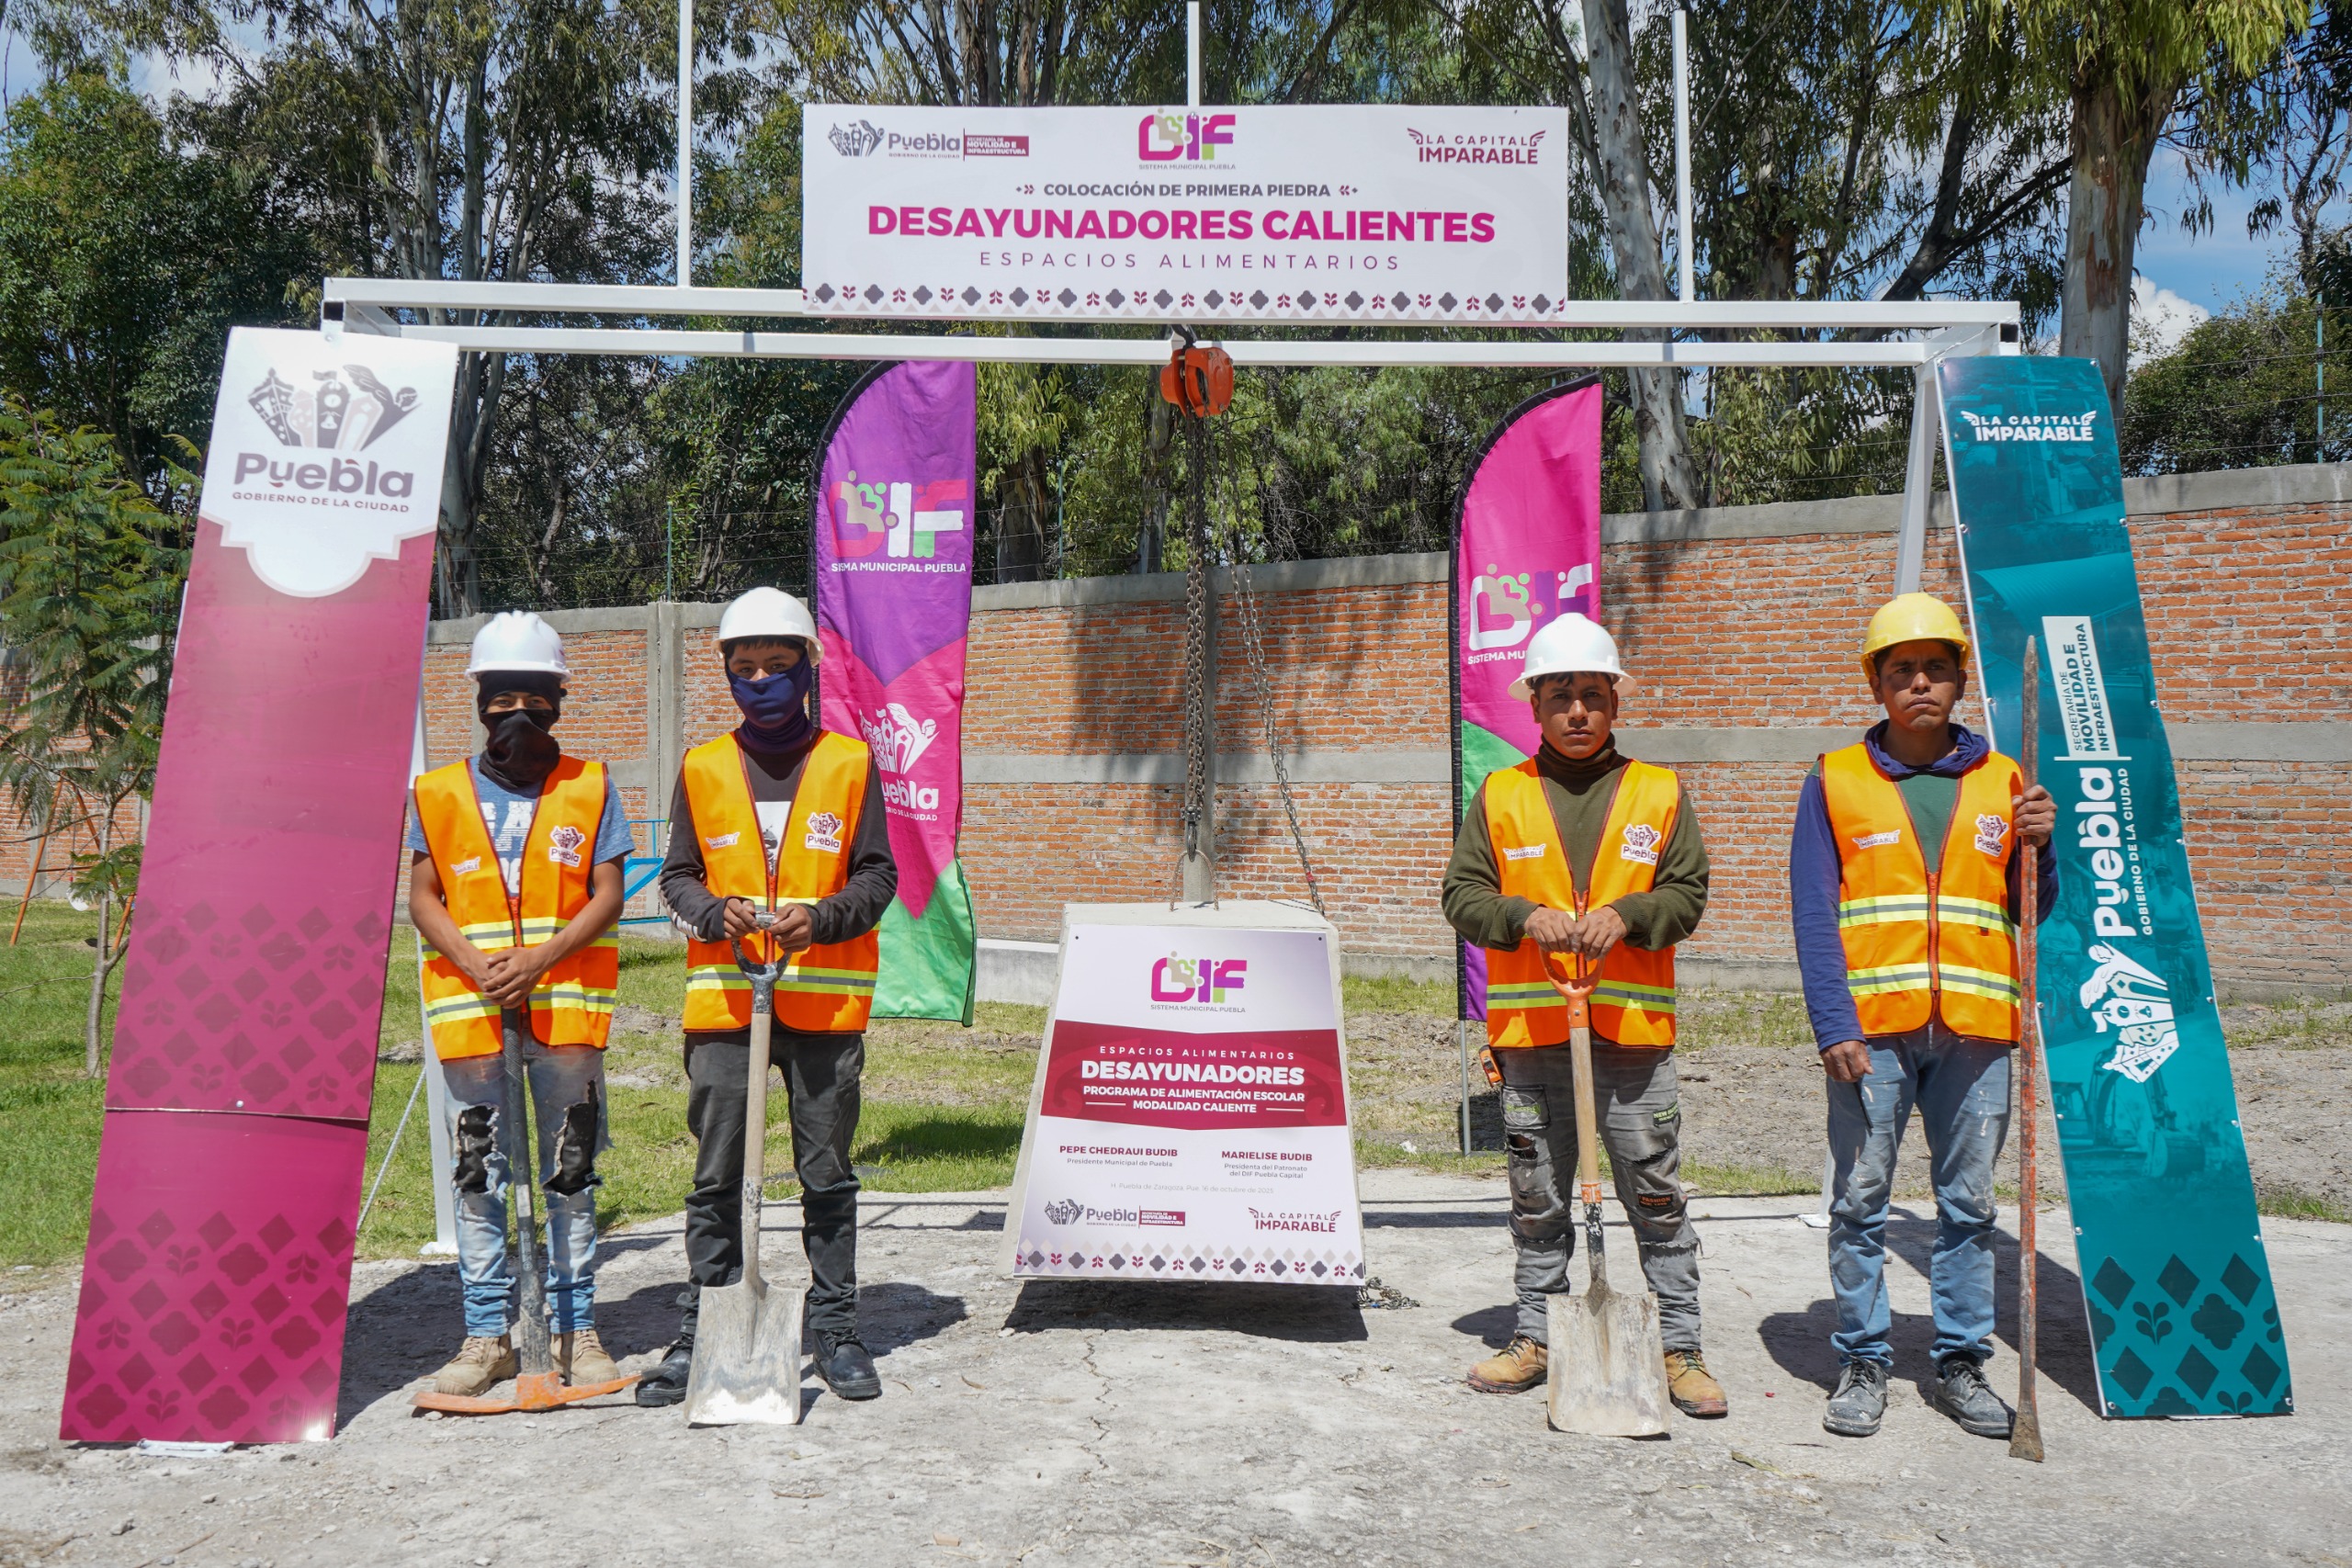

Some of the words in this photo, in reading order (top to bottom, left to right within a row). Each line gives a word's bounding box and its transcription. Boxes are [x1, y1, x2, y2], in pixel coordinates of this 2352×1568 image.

[888, 133, 960, 152] Puebla
[1427, 135, 1445, 144] LA
[1454, 135, 1528, 146] CAPITAL
[1419, 147, 1538, 164] IMPARABLE
[1044, 181, 1155, 197] COLOCACIÓN
[1159, 184, 1182, 197] DE
[1185, 184, 1263, 197] PRIMERA
[1267, 184, 1331, 197] PIEDRA
[868, 206, 1253, 240] DESAYUNADORES
[1262, 210, 1495, 243] CALIENTES
[980, 252, 1136, 268] ESPACIOS
[1159, 254, 1398, 270] ALIMENTARIOS
[1981, 415, 2002, 425] LA
[2008, 415, 2081, 425] CAPITAL
[1975, 426, 2094, 442] IMPARABLE
[233, 452, 414, 499] Puebla
[232, 491, 307, 504] GOBIERNO
[311, 497, 329, 506] DE
[334, 499, 350, 508] LA
[354, 501, 410, 513] CIUDAD
[859, 562, 922, 572] MUNICIPAL
[924, 563, 967, 573] PUEBLA
[2063, 644, 2076, 655] E
[1467, 651, 1506, 665] SISTEMA
[2060, 671, 2070, 685] DE
[2075, 623, 2110, 751] INFRAESTRUCTURA
[2067, 657, 2097, 752] MOVILIDAD
[2062, 687, 2084, 751] SECRETARÍA
[882, 779, 939, 810] uebla
[2118, 768, 2134, 820] CIUDAD
[2125, 823, 2137, 840] LA
[808, 835, 840, 848] Puebla
[1623, 845, 1657, 861] Puebla
[2075, 767, 2137, 937] Puebla
[2128, 844, 2140, 861] DE
[2131, 864, 2153, 936] GOBIERNO
[1100, 1046, 1172, 1056] ESPACIOS
[1182, 1049, 1295, 1060] ALIMENTARIOS
[1081, 1060, 1305, 1086] DESAYUNADORES
[1083, 1086, 1148, 1097] PROGRAMA
[1150, 1088, 1165, 1097] DE
[1168, 1089, 1251, 1100] ALIMENTACIÓN
[1253, 1091, 1305, 1102] ESCOLAR
[1133, 1100, 1201, 1111] MODALIDAD
[1203, 1102, 1257, 1113] CALIENTE
[1059, 1145, 1087, 1154] PEPE
[1089, 1146, 1143, 1156] CHEDRAUI
[1146, 1148, 1178, 1156] BUDIB
[1221, 1151, 1278, 1160] MARIELISE
[1280, 1153, 1313, 1161] BUDIB
[1086, 1208, 1137, 1222] Puebla
[1280, 1213, 1329, 1221] CAPITAL
[1255, 1220, 1337, 1233] IMPARABLE
